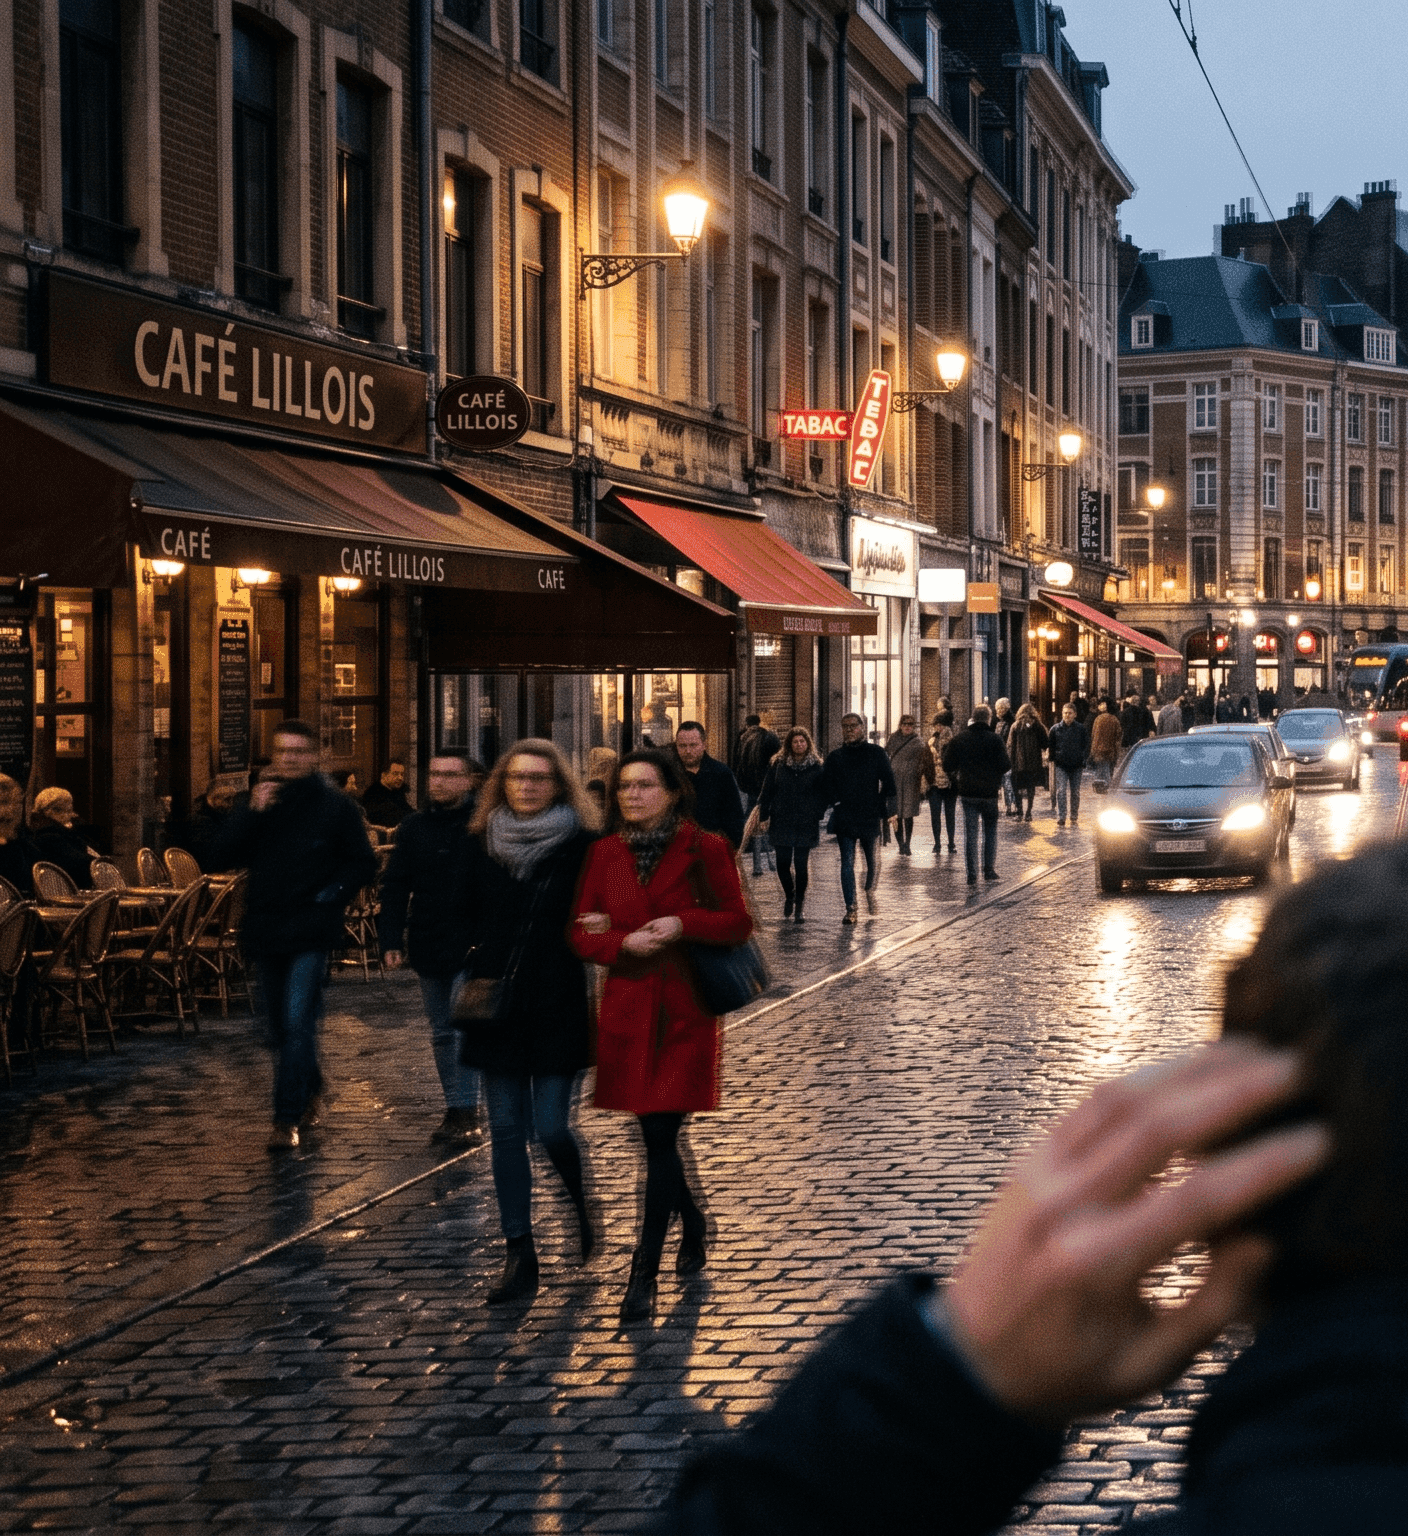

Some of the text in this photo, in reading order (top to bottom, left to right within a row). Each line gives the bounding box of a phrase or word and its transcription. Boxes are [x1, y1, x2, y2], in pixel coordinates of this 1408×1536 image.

[134, 320, 375, 431] CAFÉ LILLOIS
[458, 389, 506, 409] CAFÉ
[447, 414, 518, 430] LILLOIS
[783, 415, 848, 436] TABAC
[161, 526, 212, 560] CAFÉ
[340, 544, 445, 582] CAFÉ LILLOIS
[537, 565, 566, 590] CAFÉ
